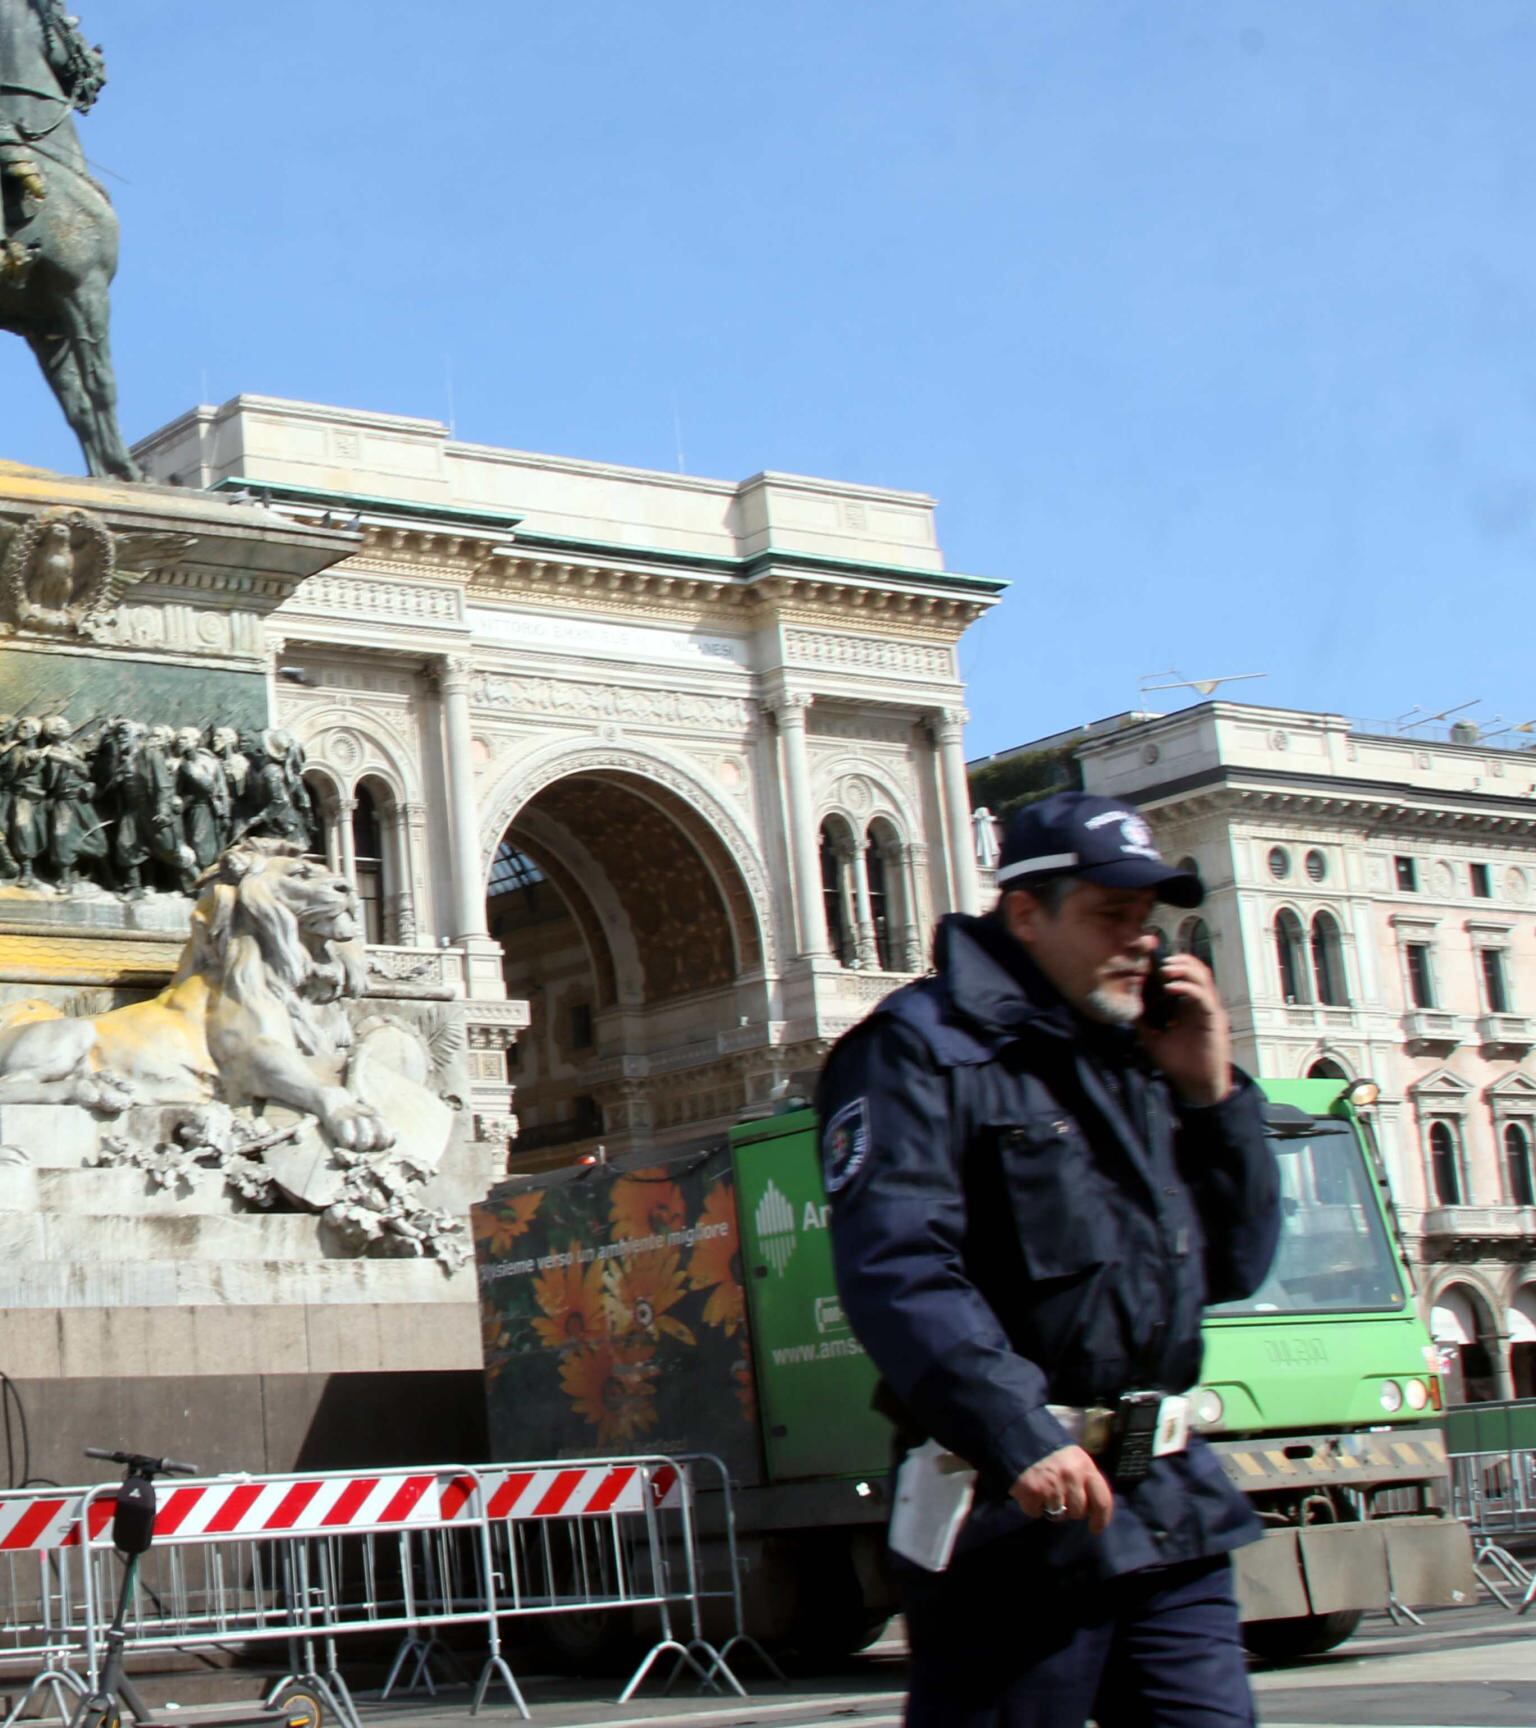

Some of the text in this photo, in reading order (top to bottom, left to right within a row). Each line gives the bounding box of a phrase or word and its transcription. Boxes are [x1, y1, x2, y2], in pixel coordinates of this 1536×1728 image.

[537, 1252, 573, 1269] verso
[576, 1248, 595, 1263] un
[667, 1222, 729, 1248] migliore
